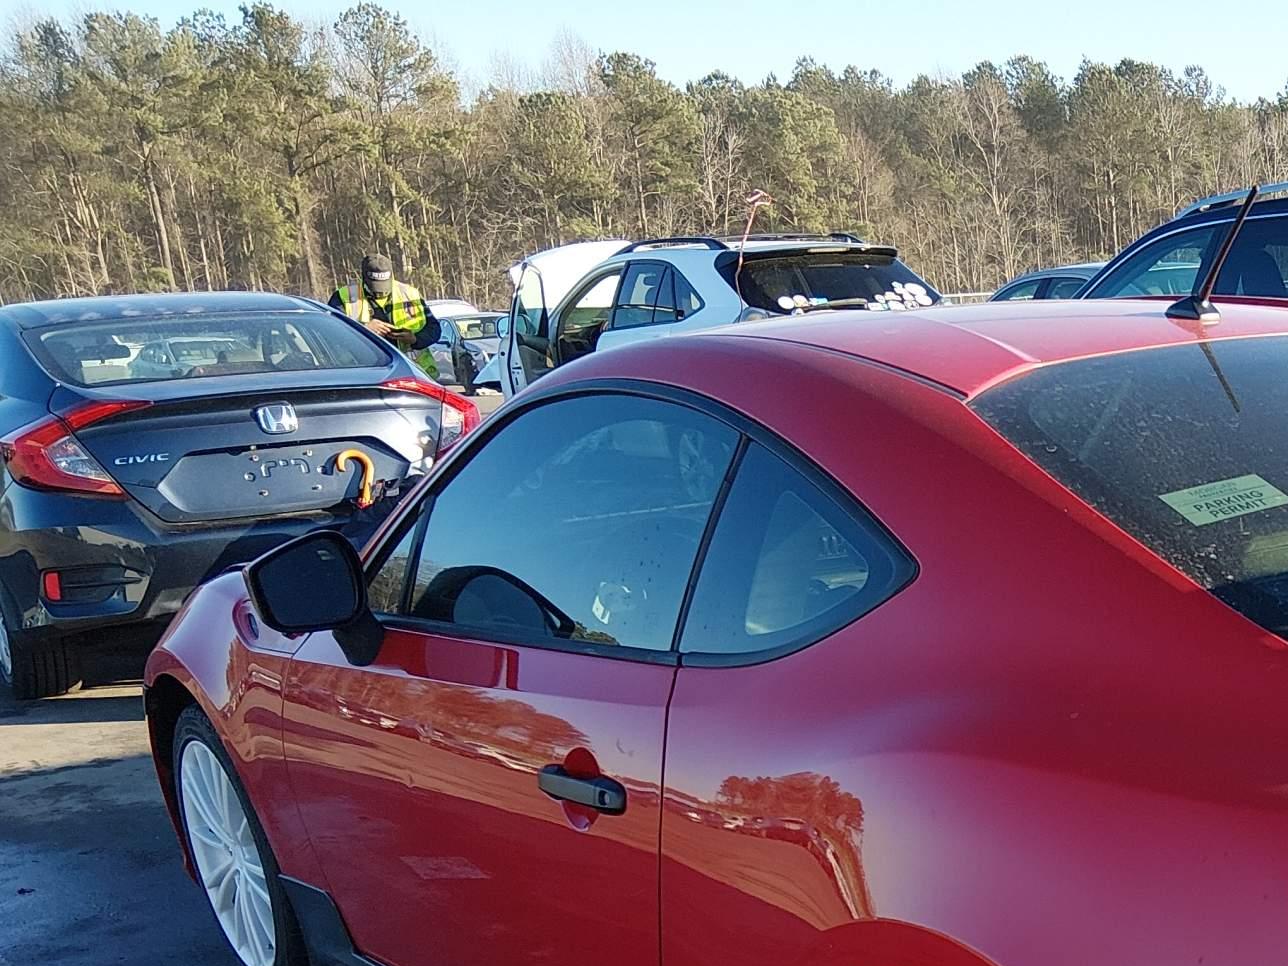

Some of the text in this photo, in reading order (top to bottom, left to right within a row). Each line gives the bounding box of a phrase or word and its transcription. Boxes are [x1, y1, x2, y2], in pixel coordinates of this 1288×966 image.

[114, 453, 169, 465] CIVIC
[1193, 490, 1264, 512] PARKING
[1208, 499, 1268, 518] PERMIT
